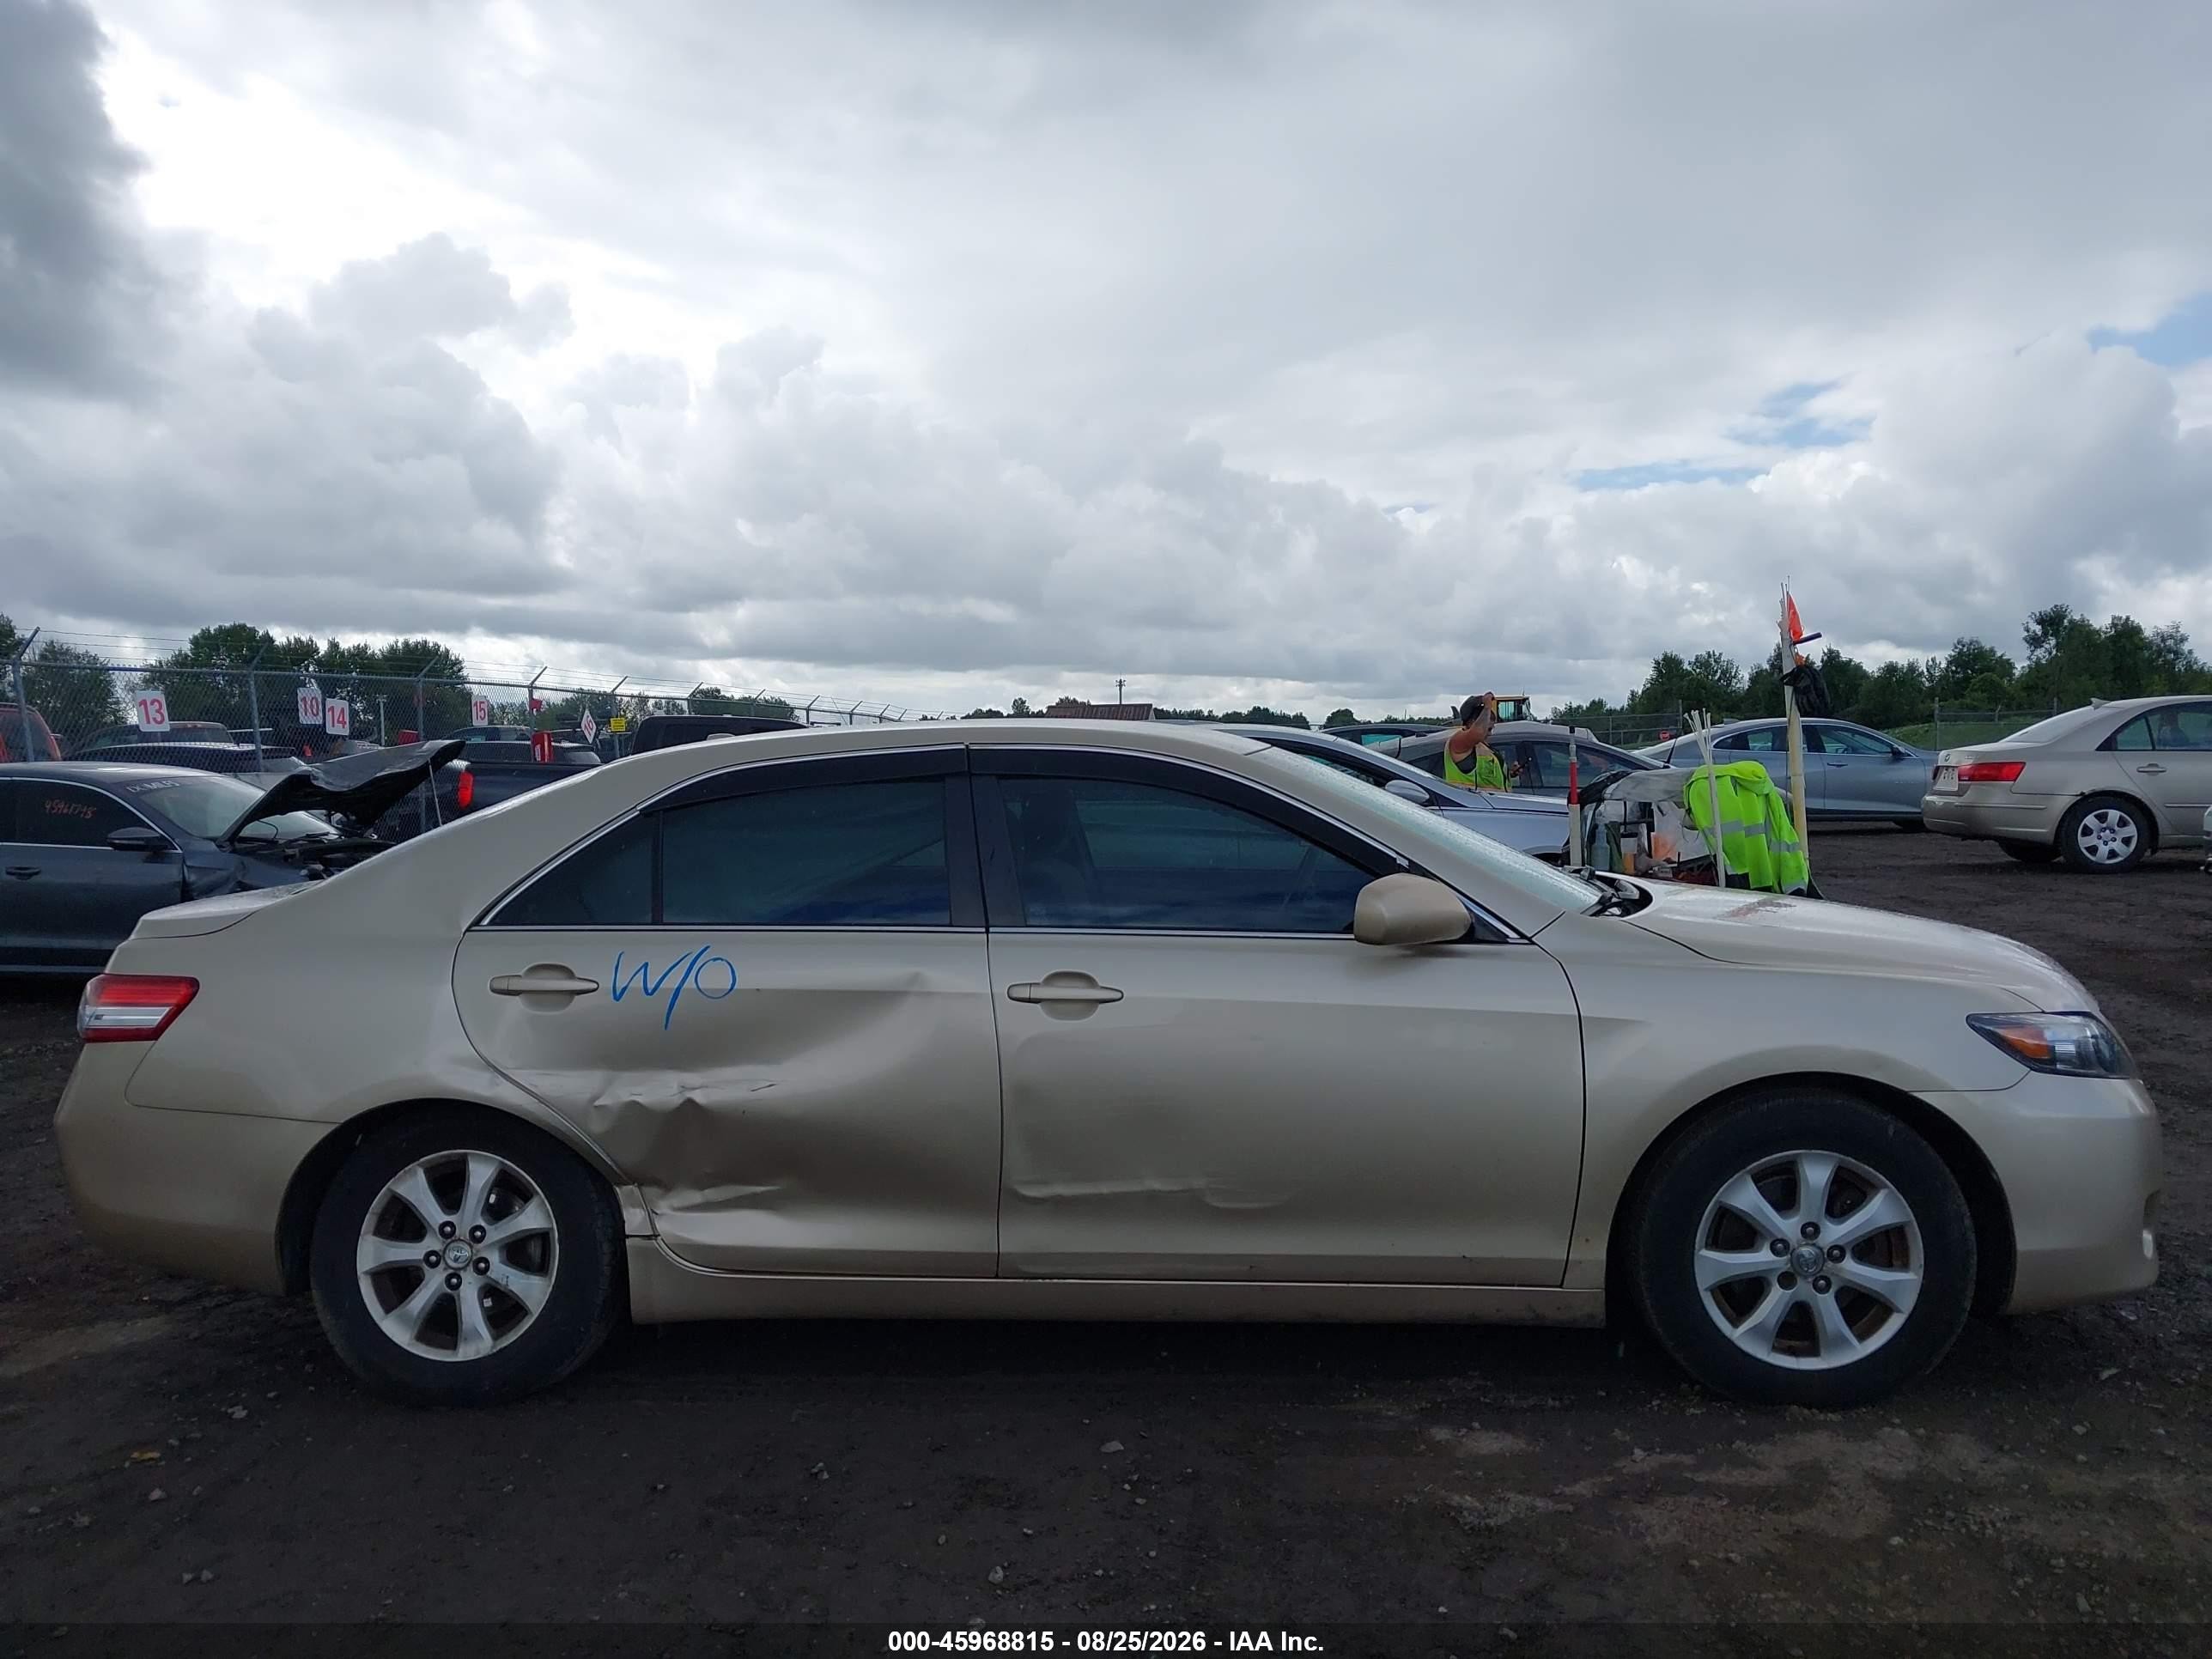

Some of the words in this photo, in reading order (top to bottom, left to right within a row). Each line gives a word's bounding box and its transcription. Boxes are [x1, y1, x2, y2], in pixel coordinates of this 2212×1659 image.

[138, 698, 166, 725] 13
[327, 705, 348, 729] 14
[473, 700, 487, 721] 15
